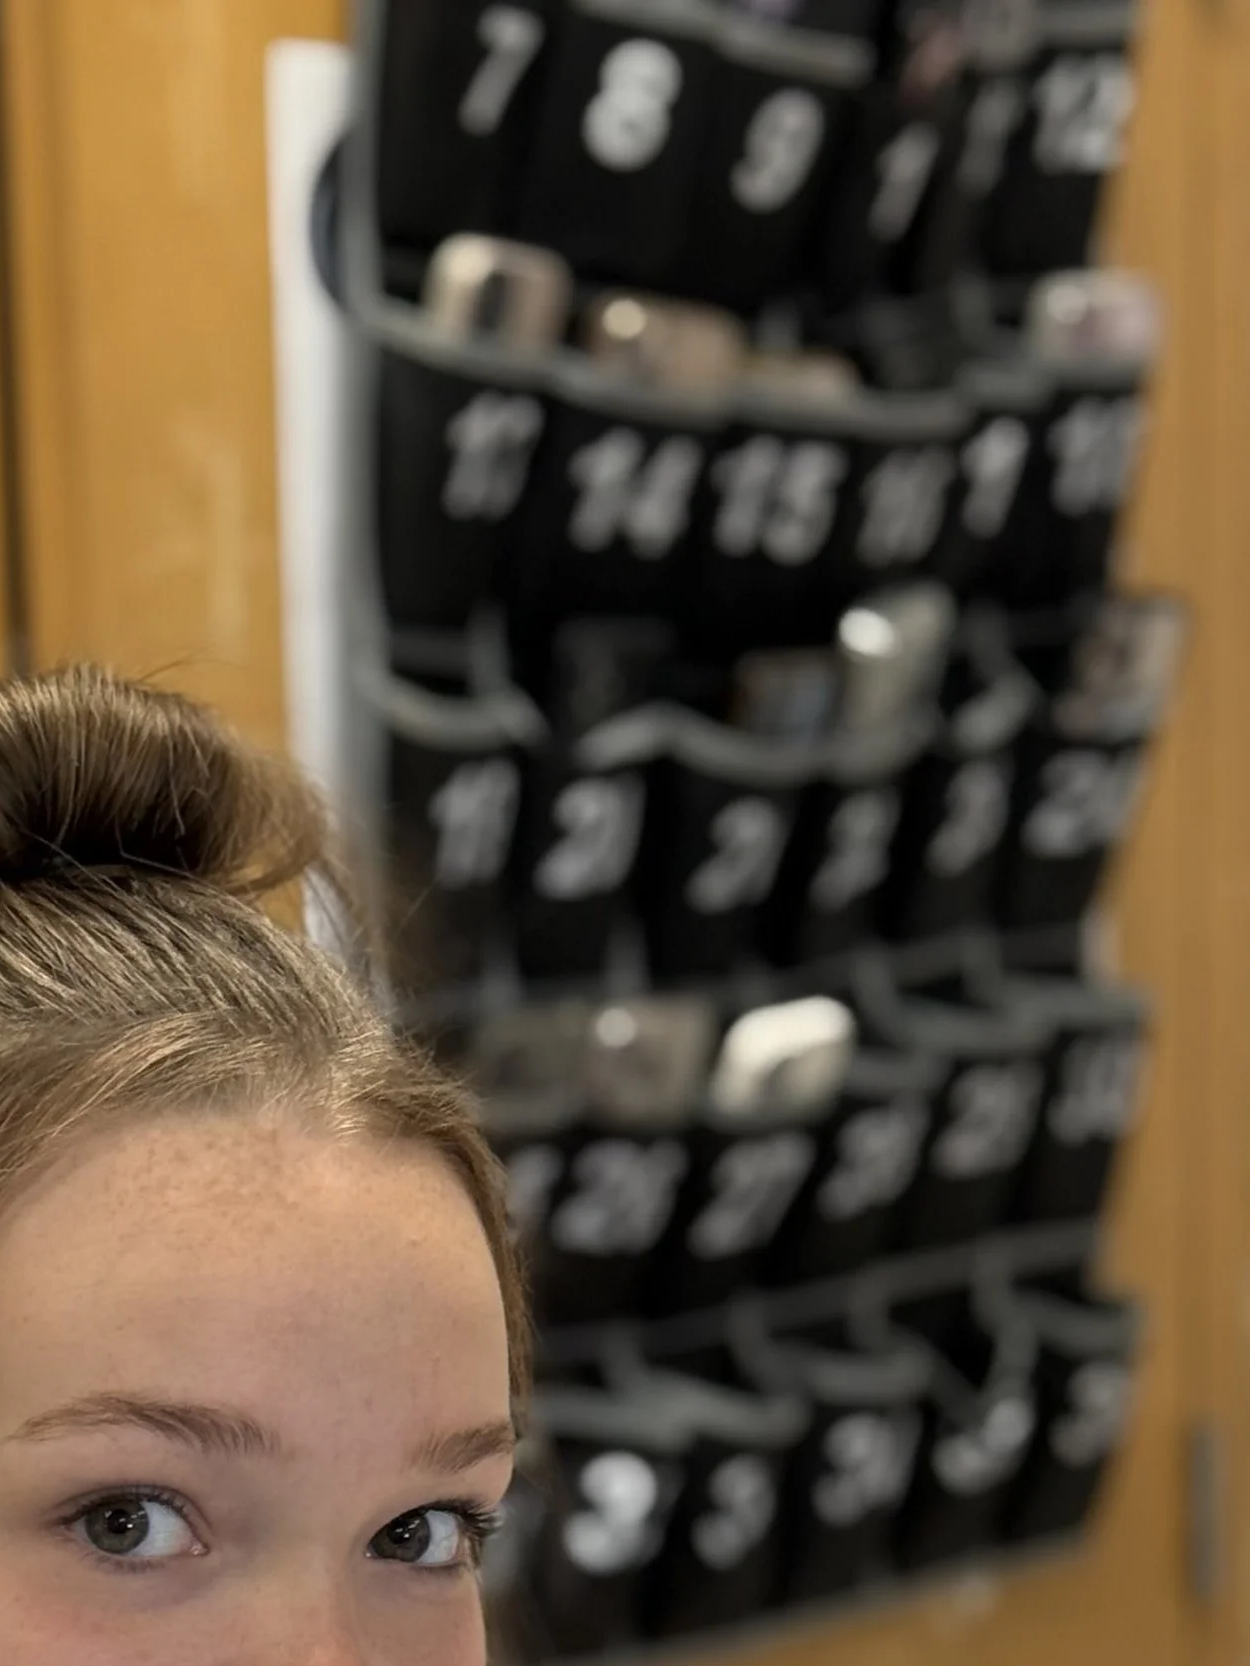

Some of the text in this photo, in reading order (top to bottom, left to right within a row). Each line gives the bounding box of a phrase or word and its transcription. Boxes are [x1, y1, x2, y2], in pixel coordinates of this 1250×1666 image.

[457, 8, 546, 136] 7
[580, 38, 684, 172] 8
[730, 86, 826, 214] 9
[569, 426, 705, 560] 14
[712, 432, 846, 567] 15
